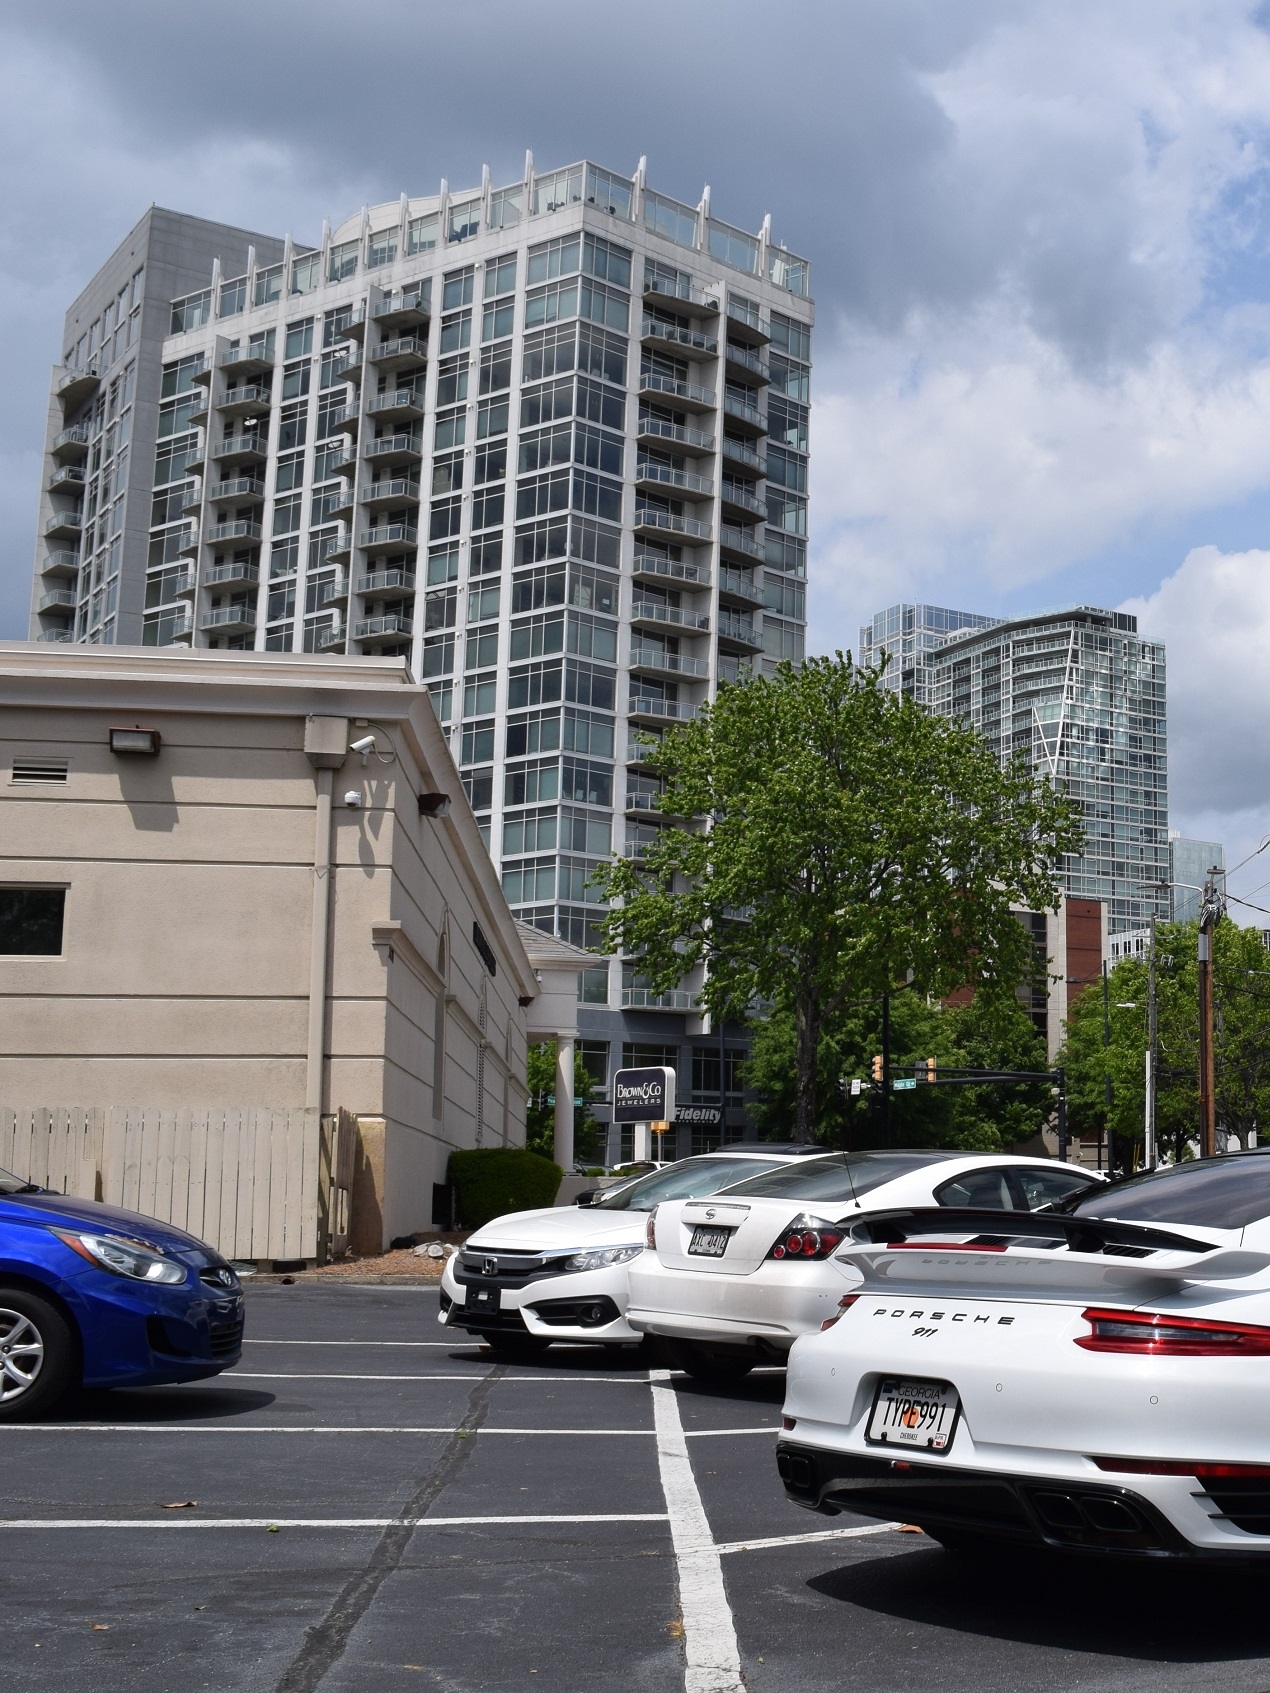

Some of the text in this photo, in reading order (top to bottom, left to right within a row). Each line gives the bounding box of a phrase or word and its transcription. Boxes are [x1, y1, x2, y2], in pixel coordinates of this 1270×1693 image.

[617, 1098, 661, 1106] JEWELERS
[675, 1107, 721, 1123] Fidelity
[873, 1308, 1015, 1326] PORSCHE
[912, 1327, 938, 1338] 911
[898, 1385, 940, 1400] GEORGIA
[883, 1396, 947, 1433] TYPE991
